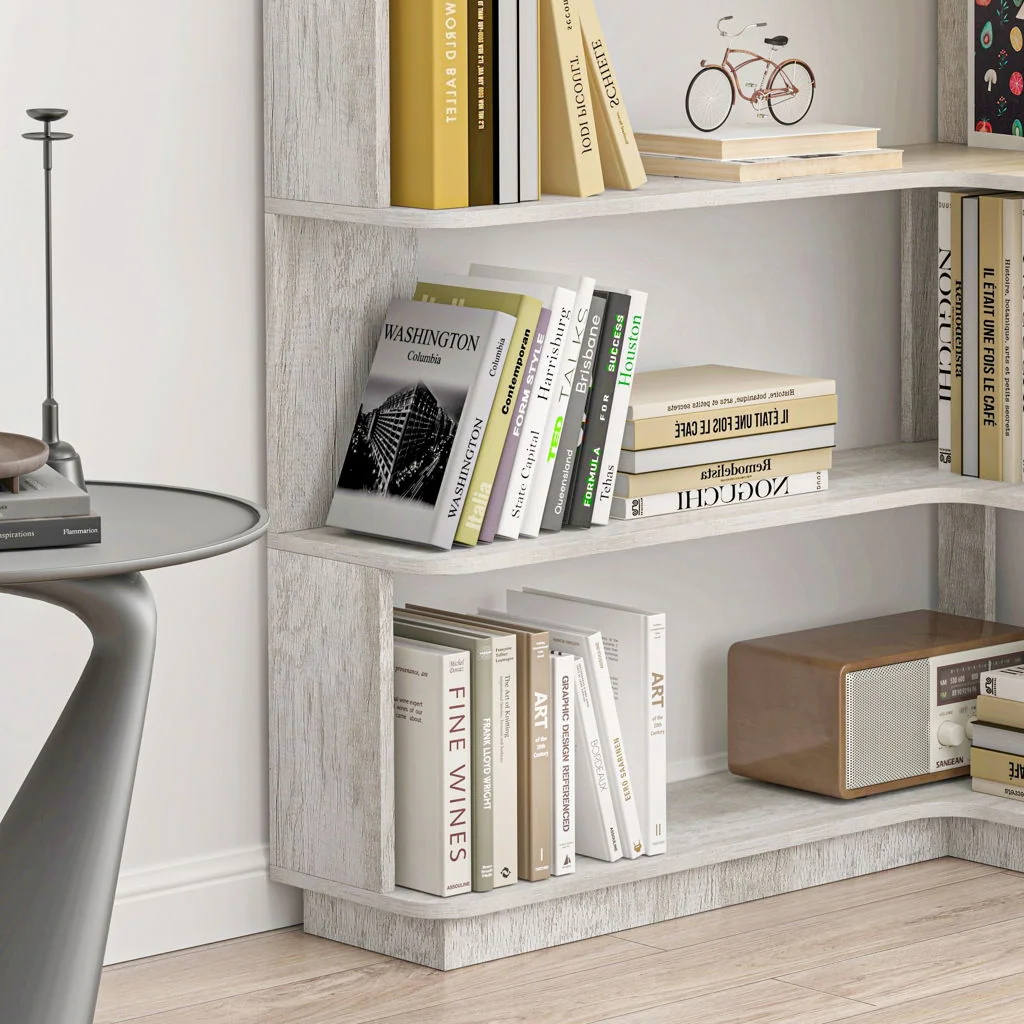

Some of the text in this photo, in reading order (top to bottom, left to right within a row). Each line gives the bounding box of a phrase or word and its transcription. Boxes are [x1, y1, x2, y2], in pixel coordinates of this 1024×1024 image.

[384, 323, 480, 352] WASHINGTON
[407, 350, 442, 365] Columbia
[617, 314, 642, 386] Houston
[939, 247, 952, 402] NOGUCHI
[501, 328, 531, 415] Contemporan
[511, 306, 571, 519] State Capital Harrisburg
[513, 333, 545, 437] FORM STYLE
[554, 314, 601, 515] Queensland Brisbane
[584, 314, 625, 507] FORMULA FOR SUCCESS
[447, 337, 506, 519] WASHINGTON Columbia
[546, 415, 564, 463] TED
[449, 686, 466, 752] FINE
[534, 691, 549, 729] ART
[651, 672, 664, 708] ART
[562, 675, 570, 832] GRAPHIC DESIGN REFERENCED
[936, 756, 964, 769] SANGEAN
[449, 764, 467, 862] WINES
